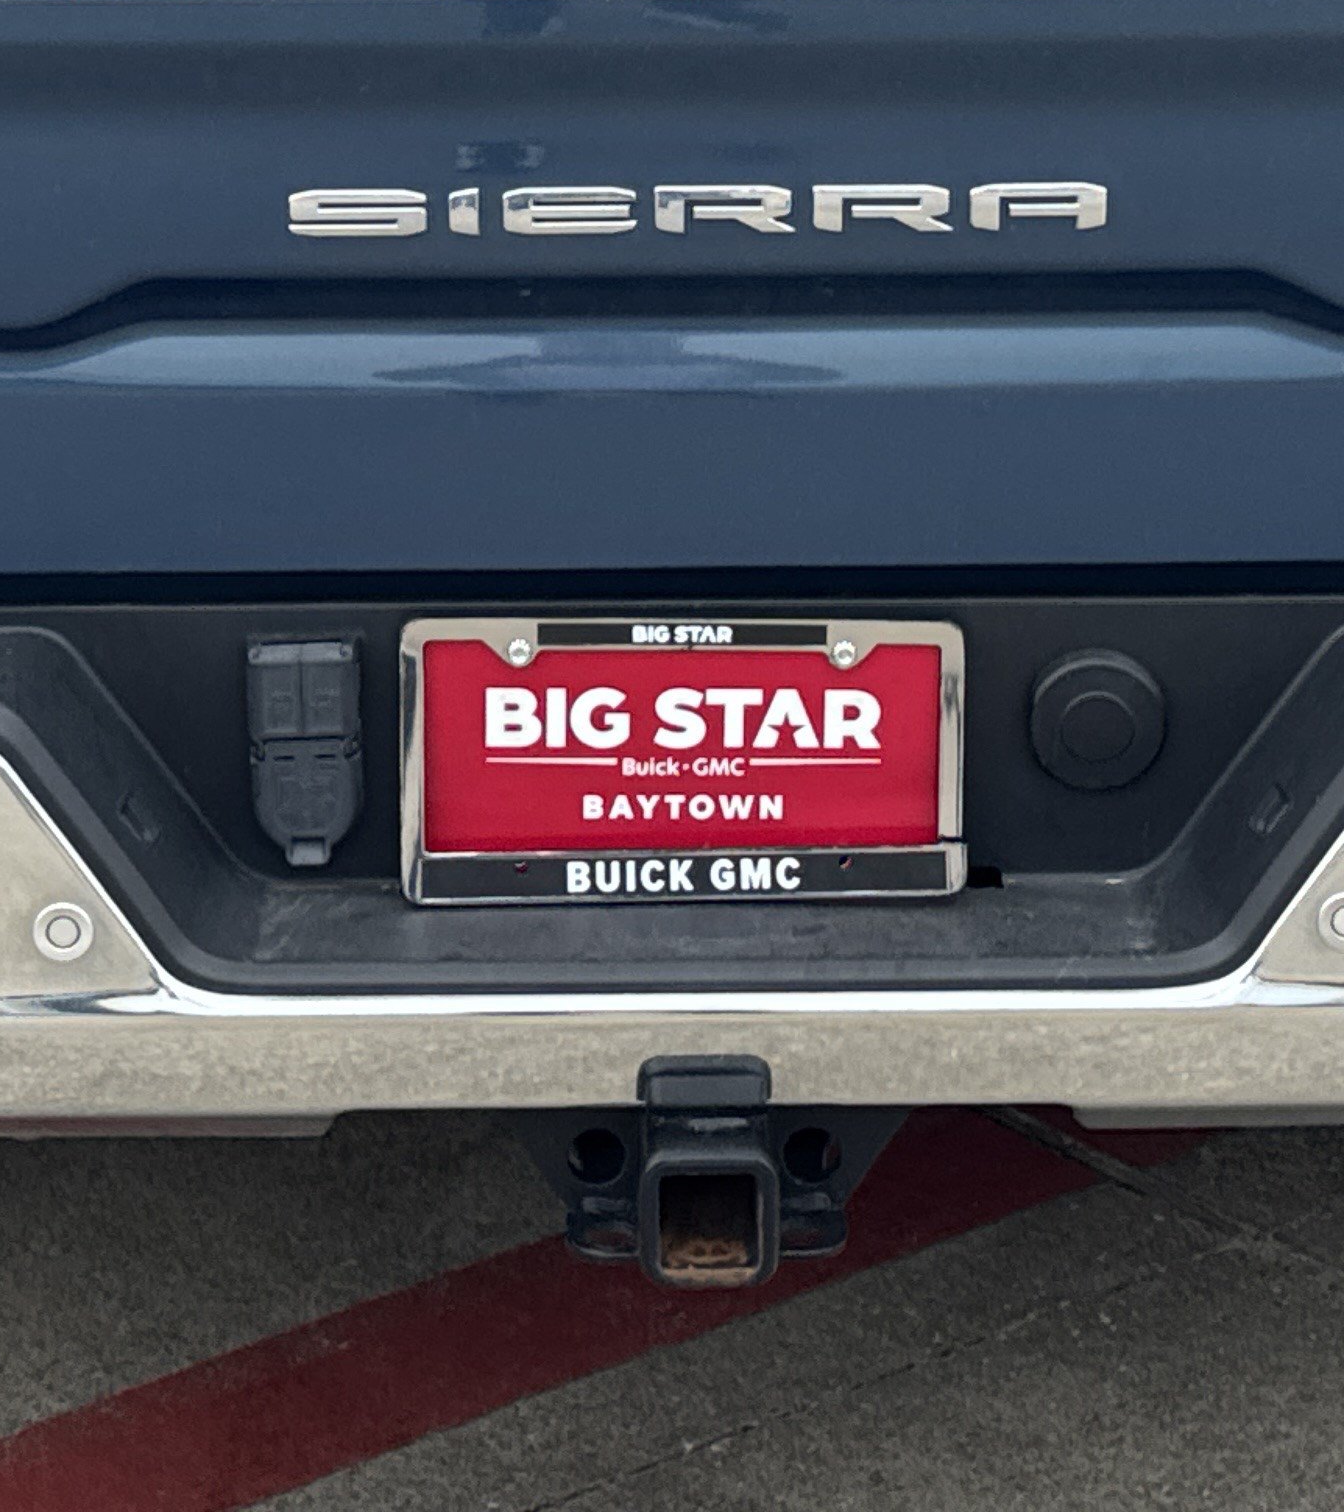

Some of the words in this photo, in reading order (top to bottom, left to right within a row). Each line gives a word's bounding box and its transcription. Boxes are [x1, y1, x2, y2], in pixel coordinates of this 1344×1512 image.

[287, 181, 1109, 238] SIERRA
[632, 624, 670, 643] BIG
[674, 624, 733, 644] STAR
[484, 686, 631, 750] BIG
[653, 686, 883, 750] STAR
[582, 794, 784, 821] BAYTOWN
[566, 858, 695, 894] BUICK
[709, 856, 801, 892] GMC
